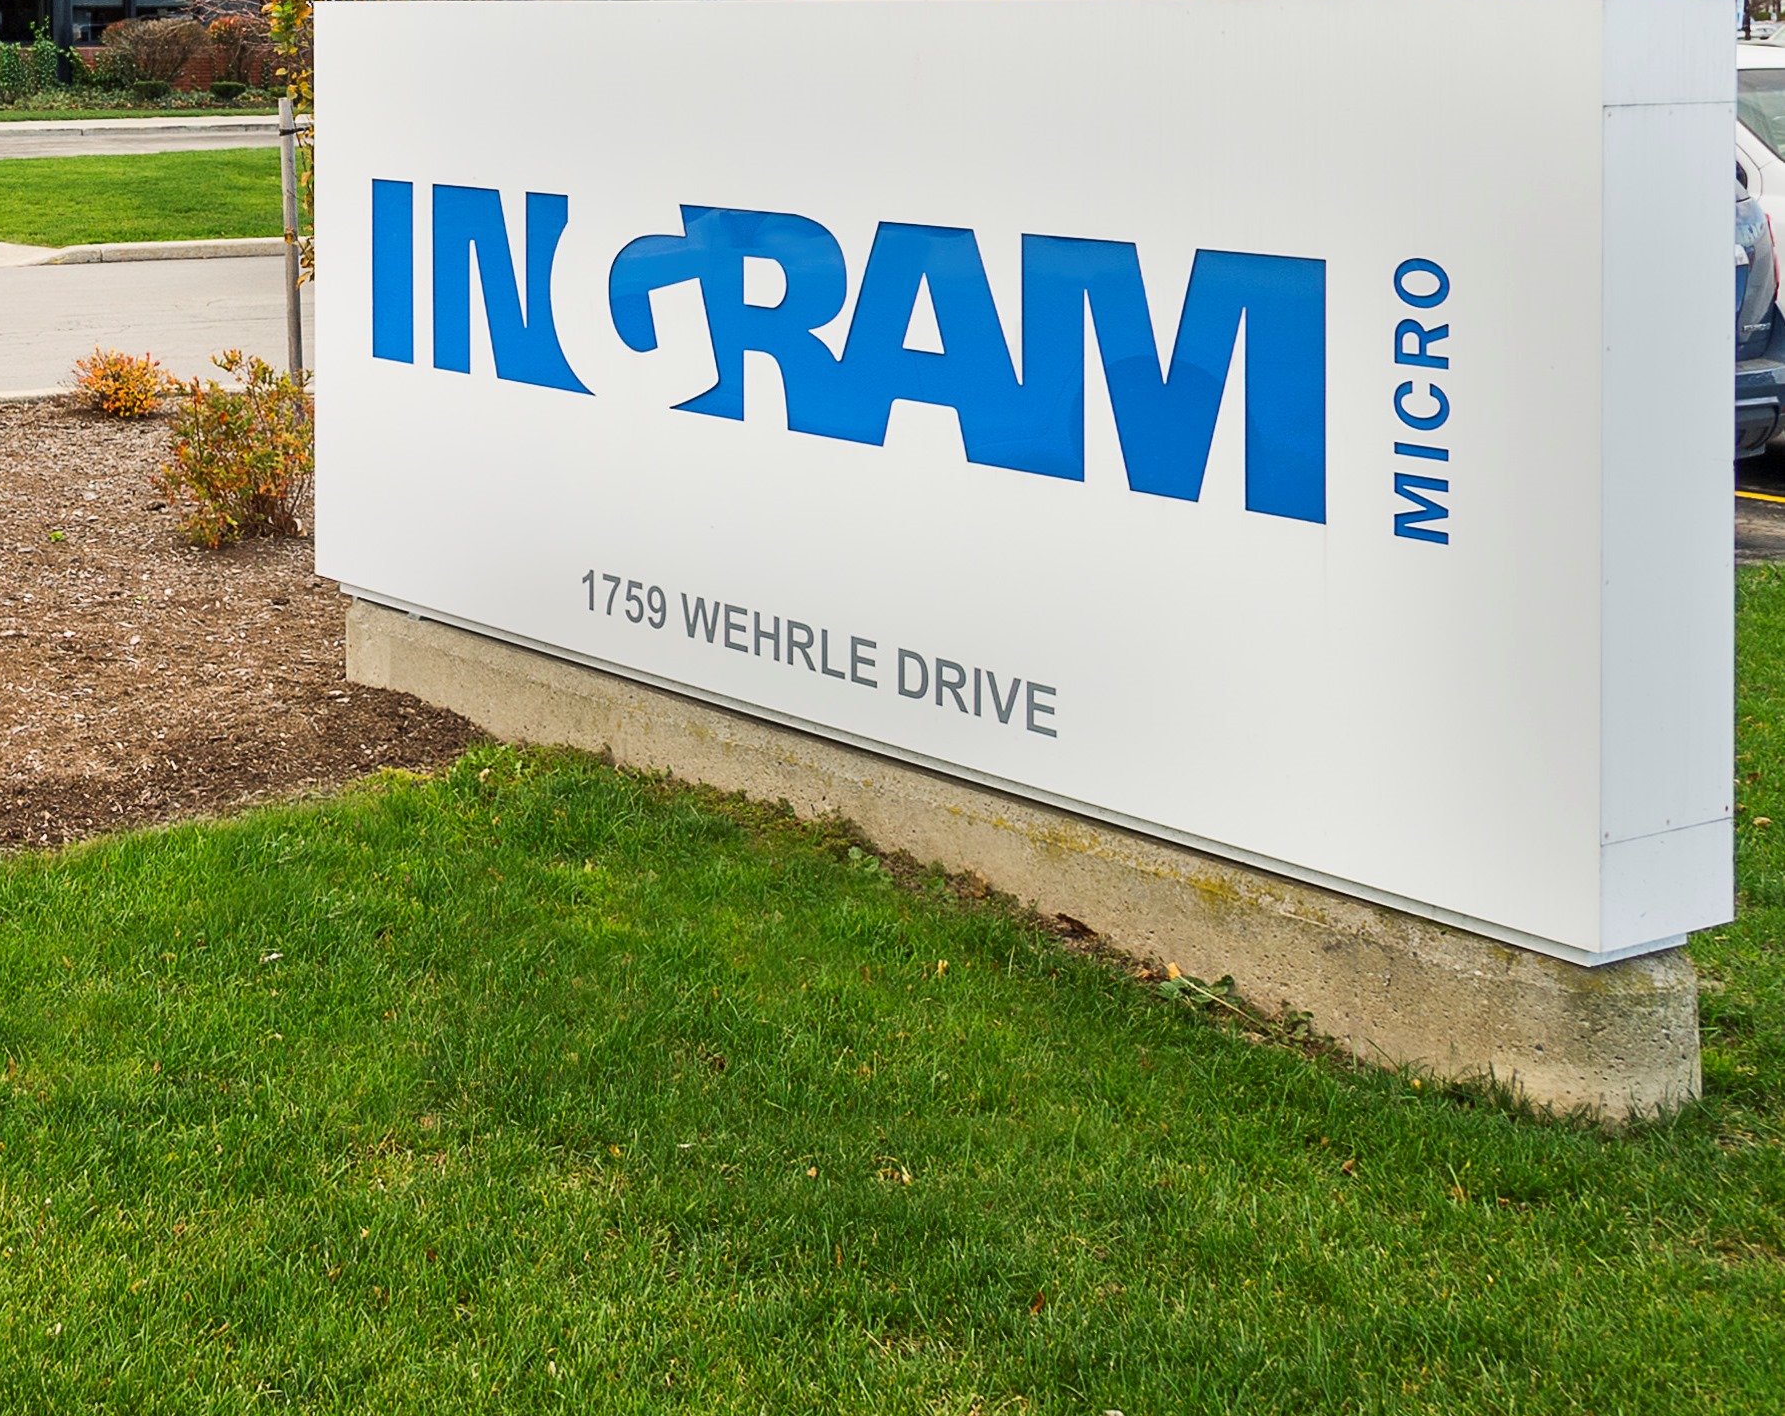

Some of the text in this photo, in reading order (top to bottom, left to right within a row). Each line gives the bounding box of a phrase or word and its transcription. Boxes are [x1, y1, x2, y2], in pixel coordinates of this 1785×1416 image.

[371, 178, 1327, 525] INGRAM
[1393, 258, 1450, 545] MICRO
[580, 569, 1058, 739] 1759 WEHRLE DRIVE
